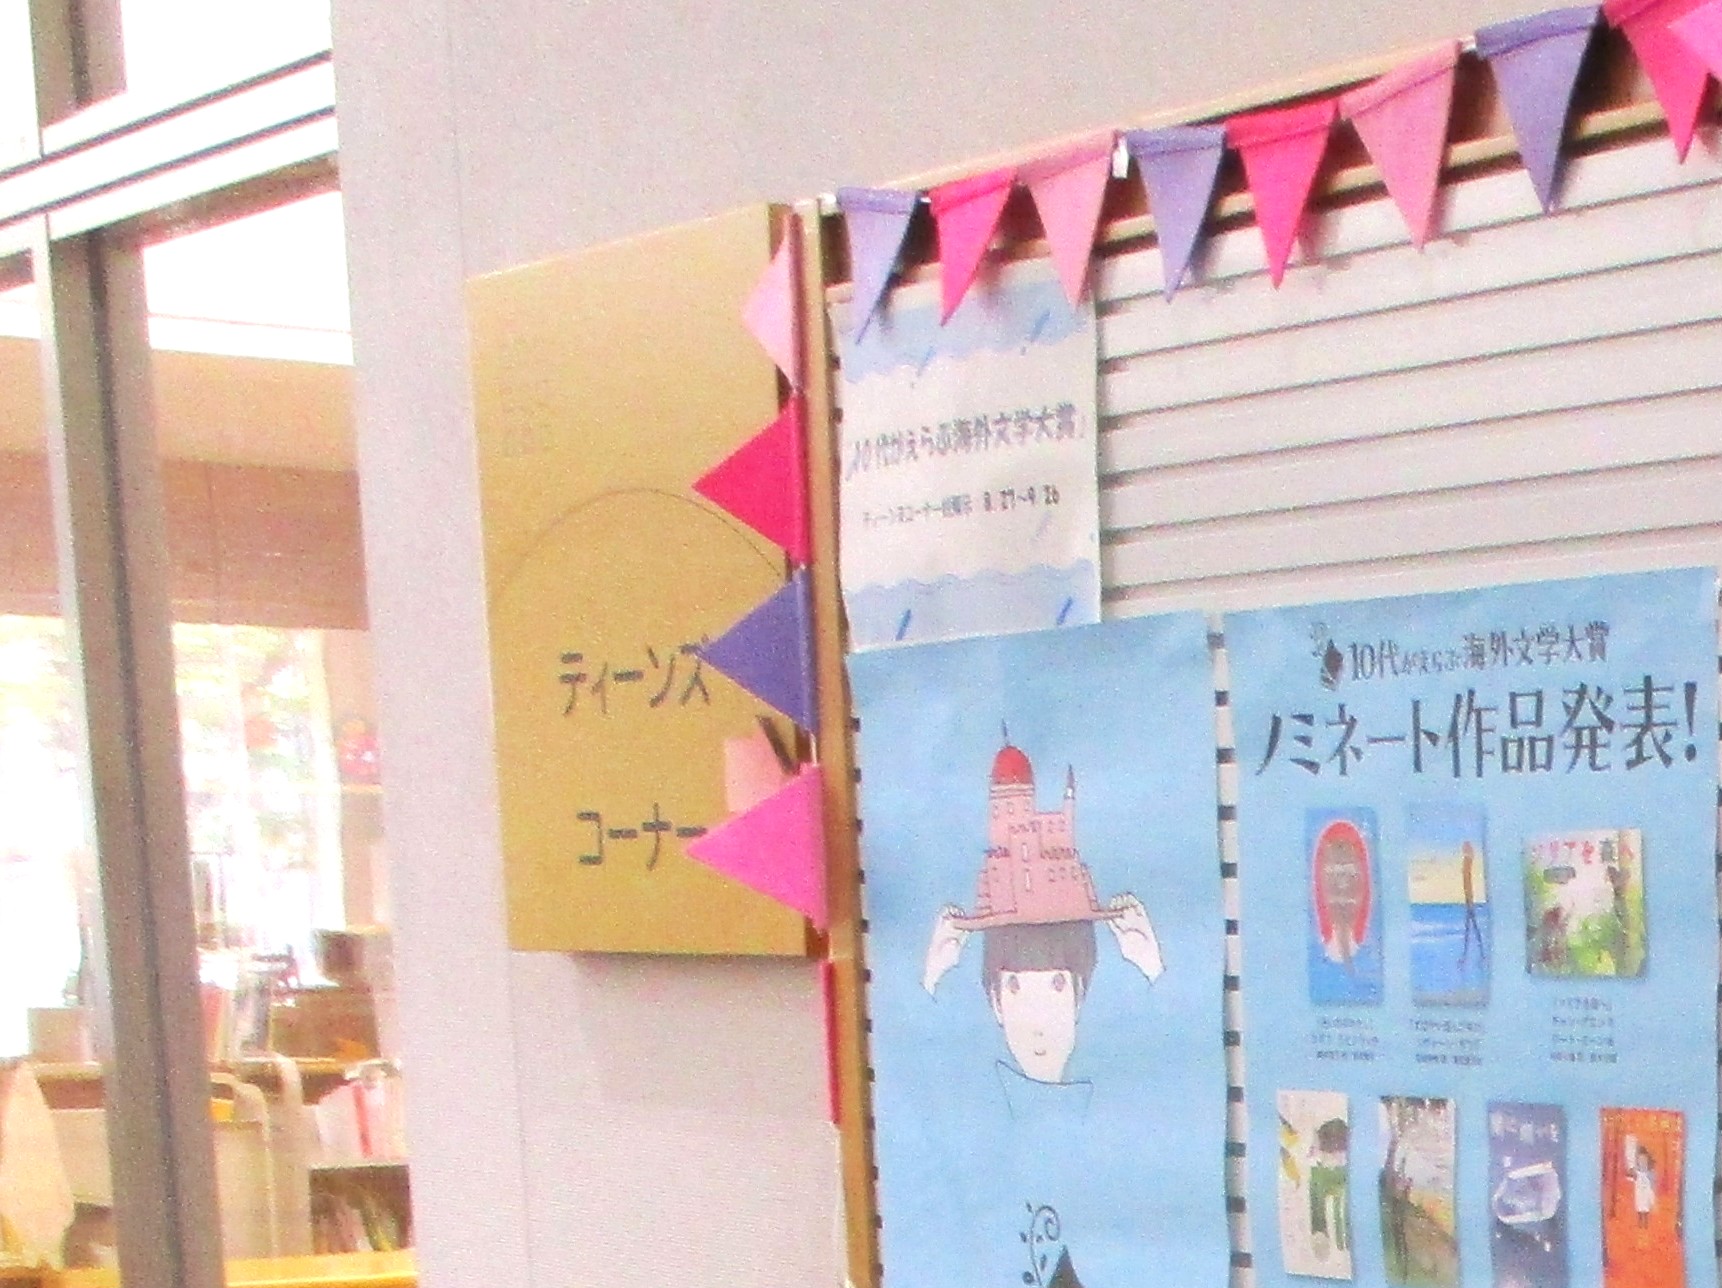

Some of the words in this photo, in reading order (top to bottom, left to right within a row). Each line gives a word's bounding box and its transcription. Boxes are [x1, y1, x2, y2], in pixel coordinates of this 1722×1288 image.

[1255, 675, 1698, 778] ノミネート作品発表!
[577, 803, 709, 870] コーナー
